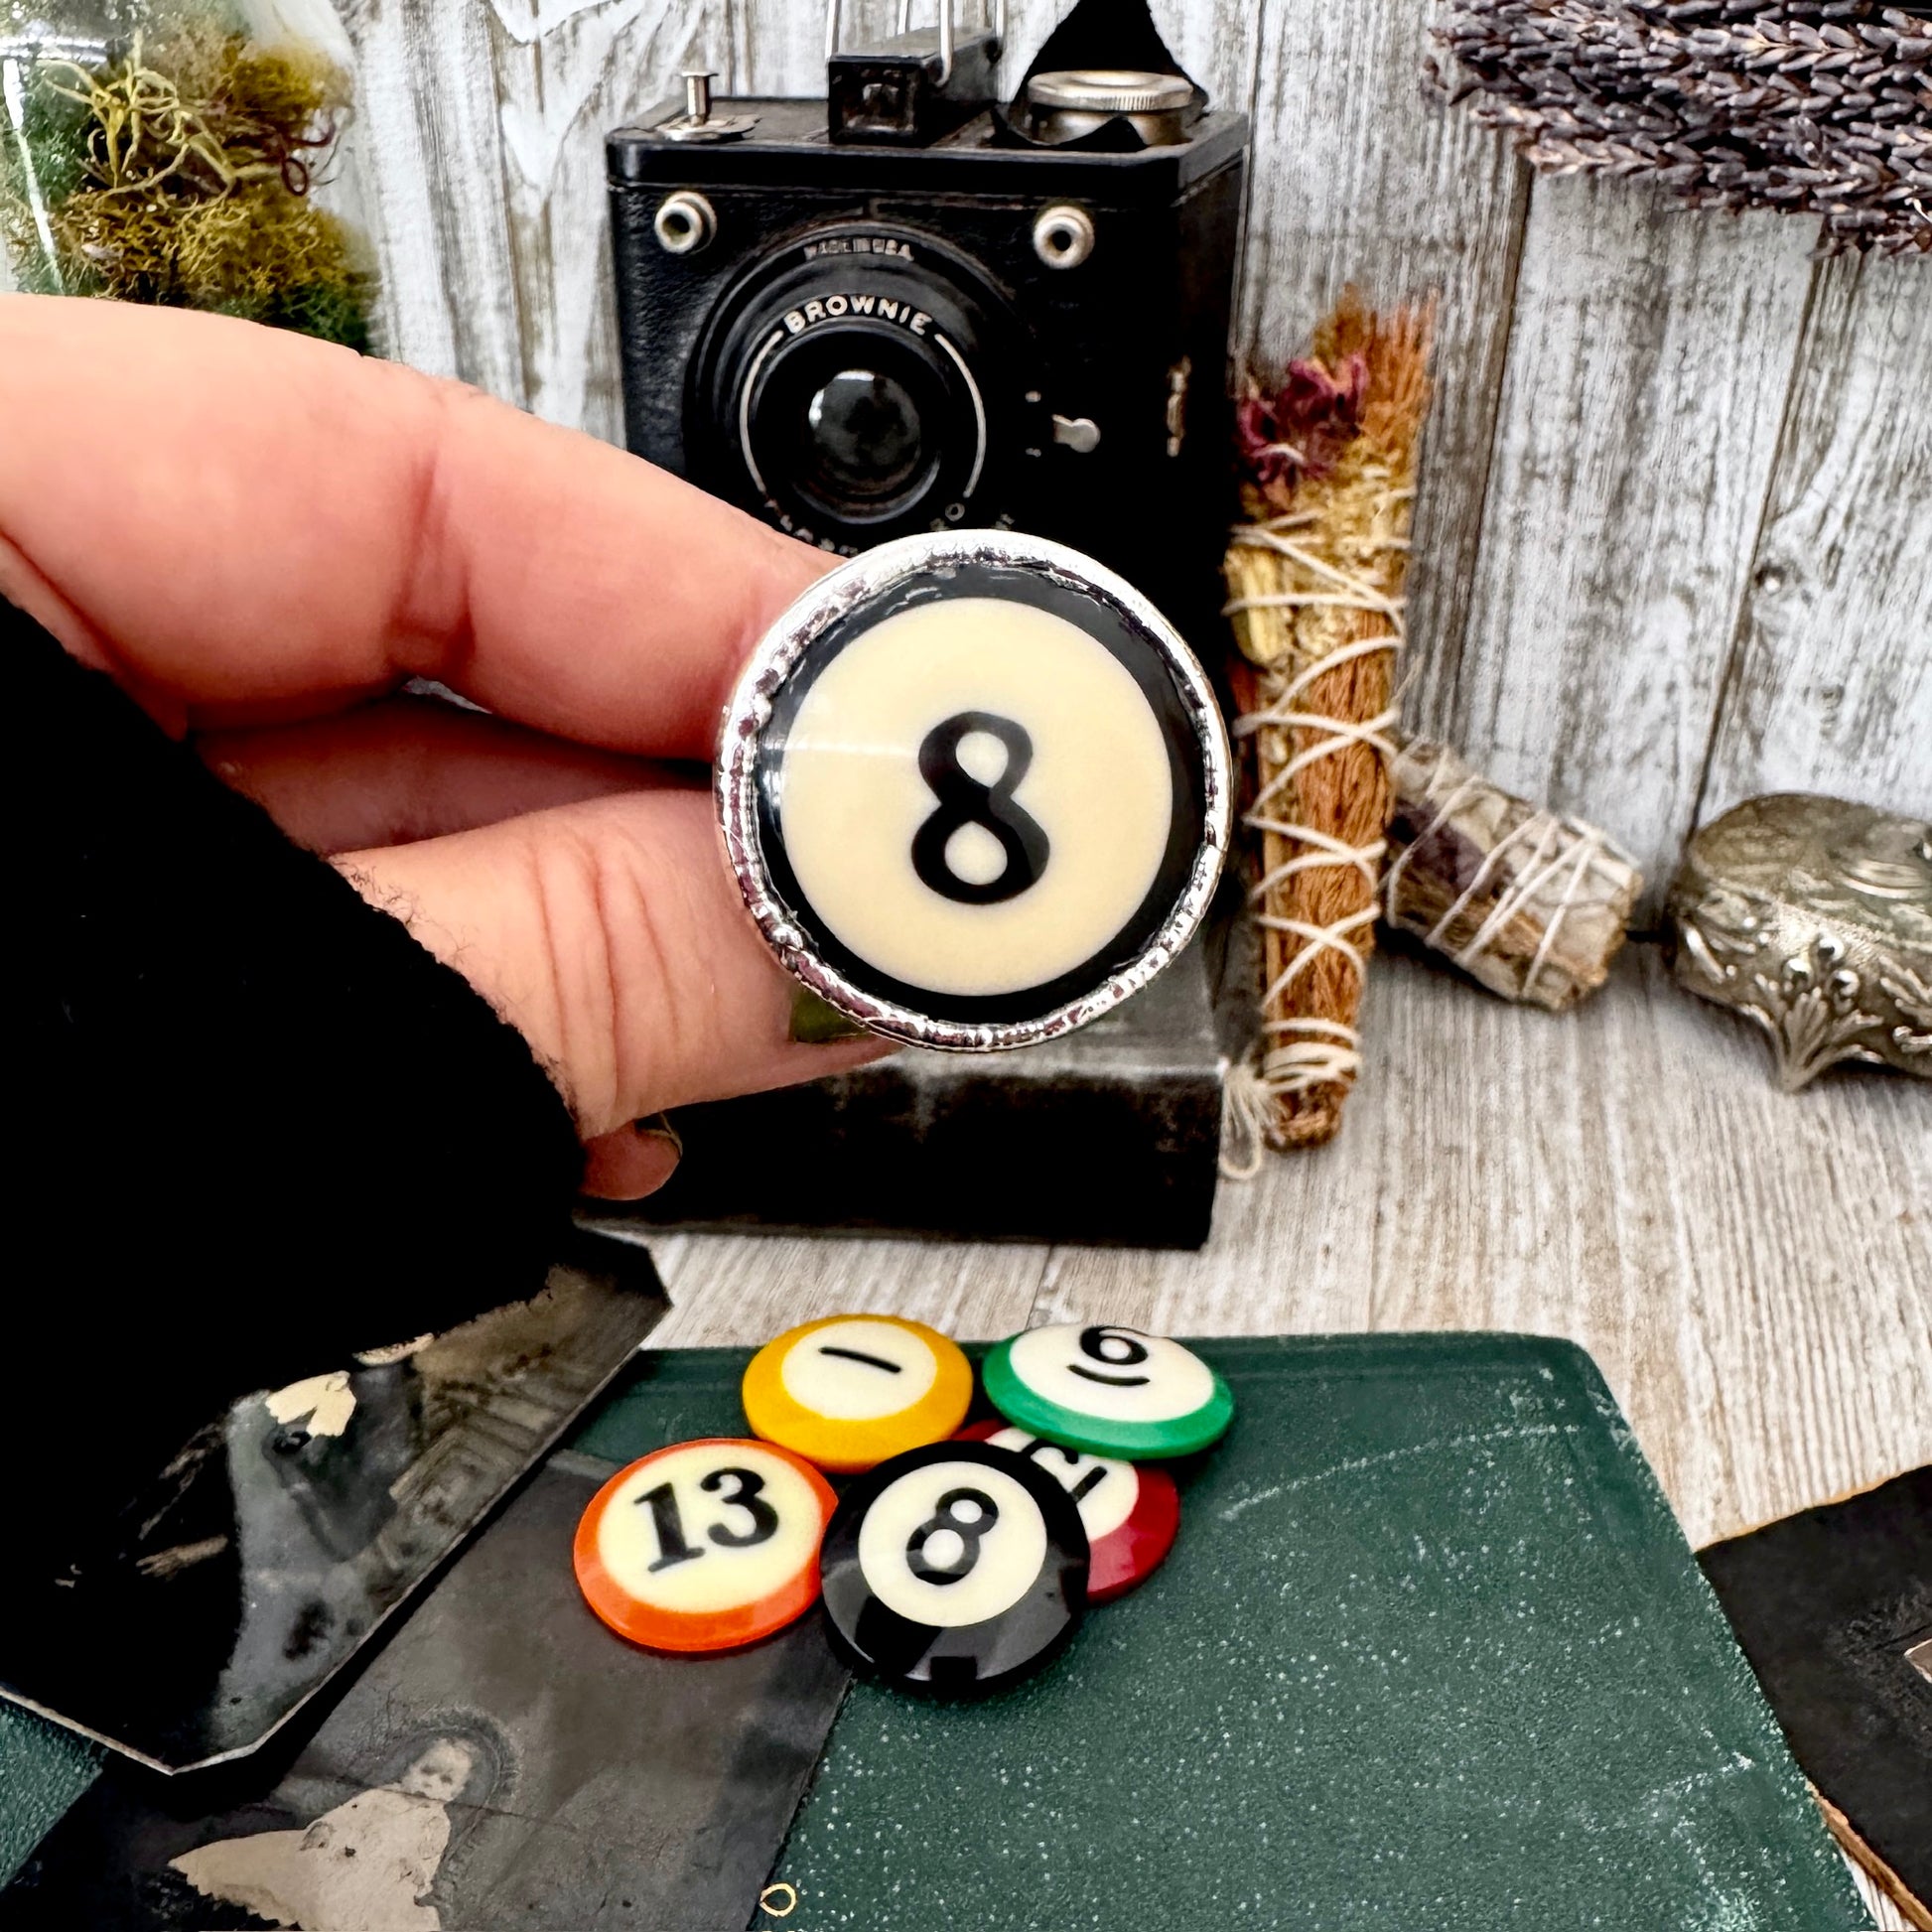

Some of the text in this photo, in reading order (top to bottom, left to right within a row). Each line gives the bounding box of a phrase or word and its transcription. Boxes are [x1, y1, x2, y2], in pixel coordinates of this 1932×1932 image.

[782, 294, 932, 336] BROWNIE
[910, 711, 1050, 906] 8
[633, 1466, 779, 1573] 13
[905, 1487, 1000, 1587] 8
